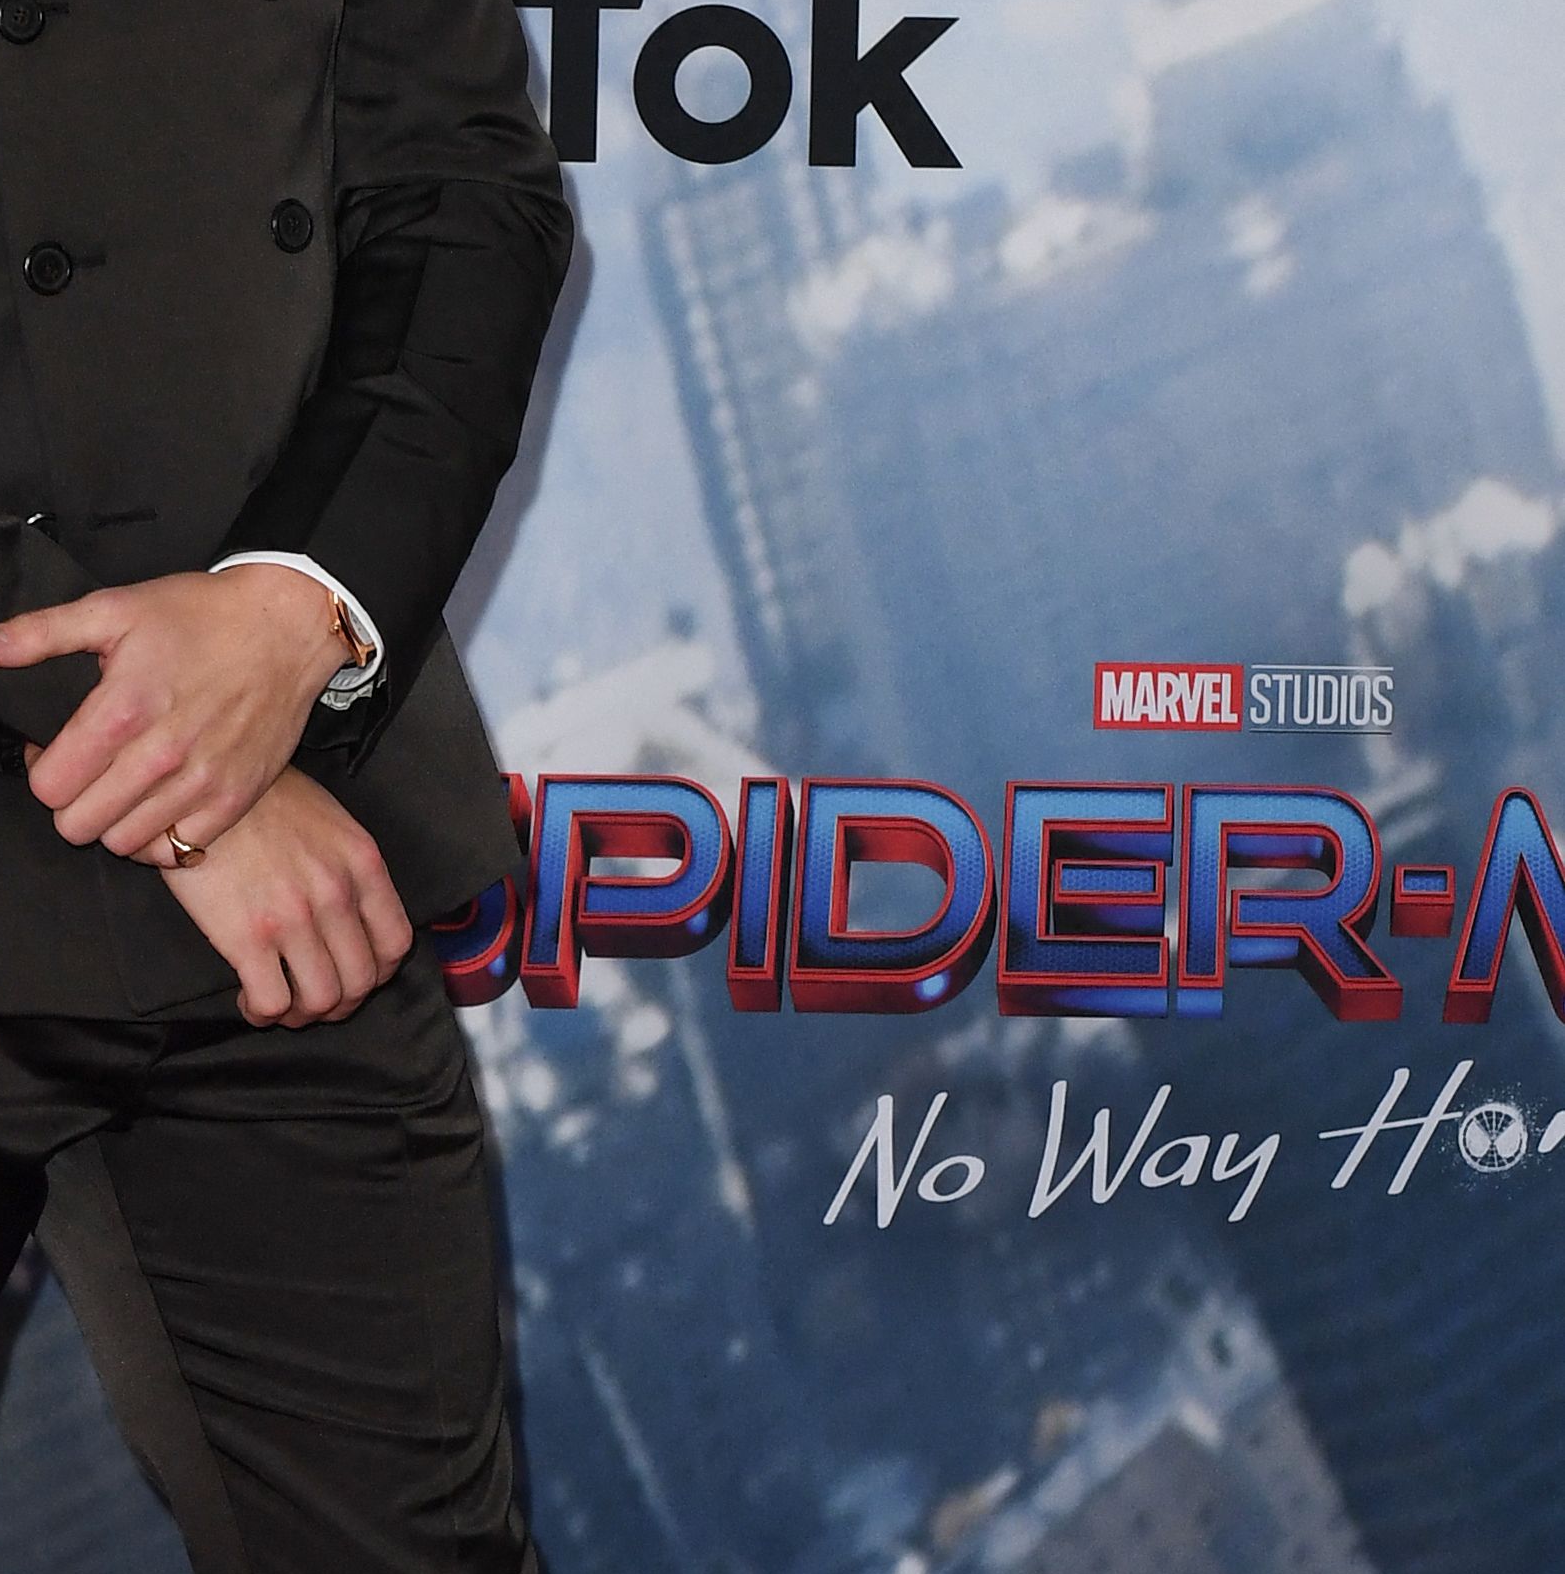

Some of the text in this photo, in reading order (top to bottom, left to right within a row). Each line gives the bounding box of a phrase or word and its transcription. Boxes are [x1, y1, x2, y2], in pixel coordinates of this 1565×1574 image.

[1100, 670, 1394, 726] MARVEL STUDIOS
[823, 1090, 987, 1229] No
[1028, 1079, 1281, 1223] Way
